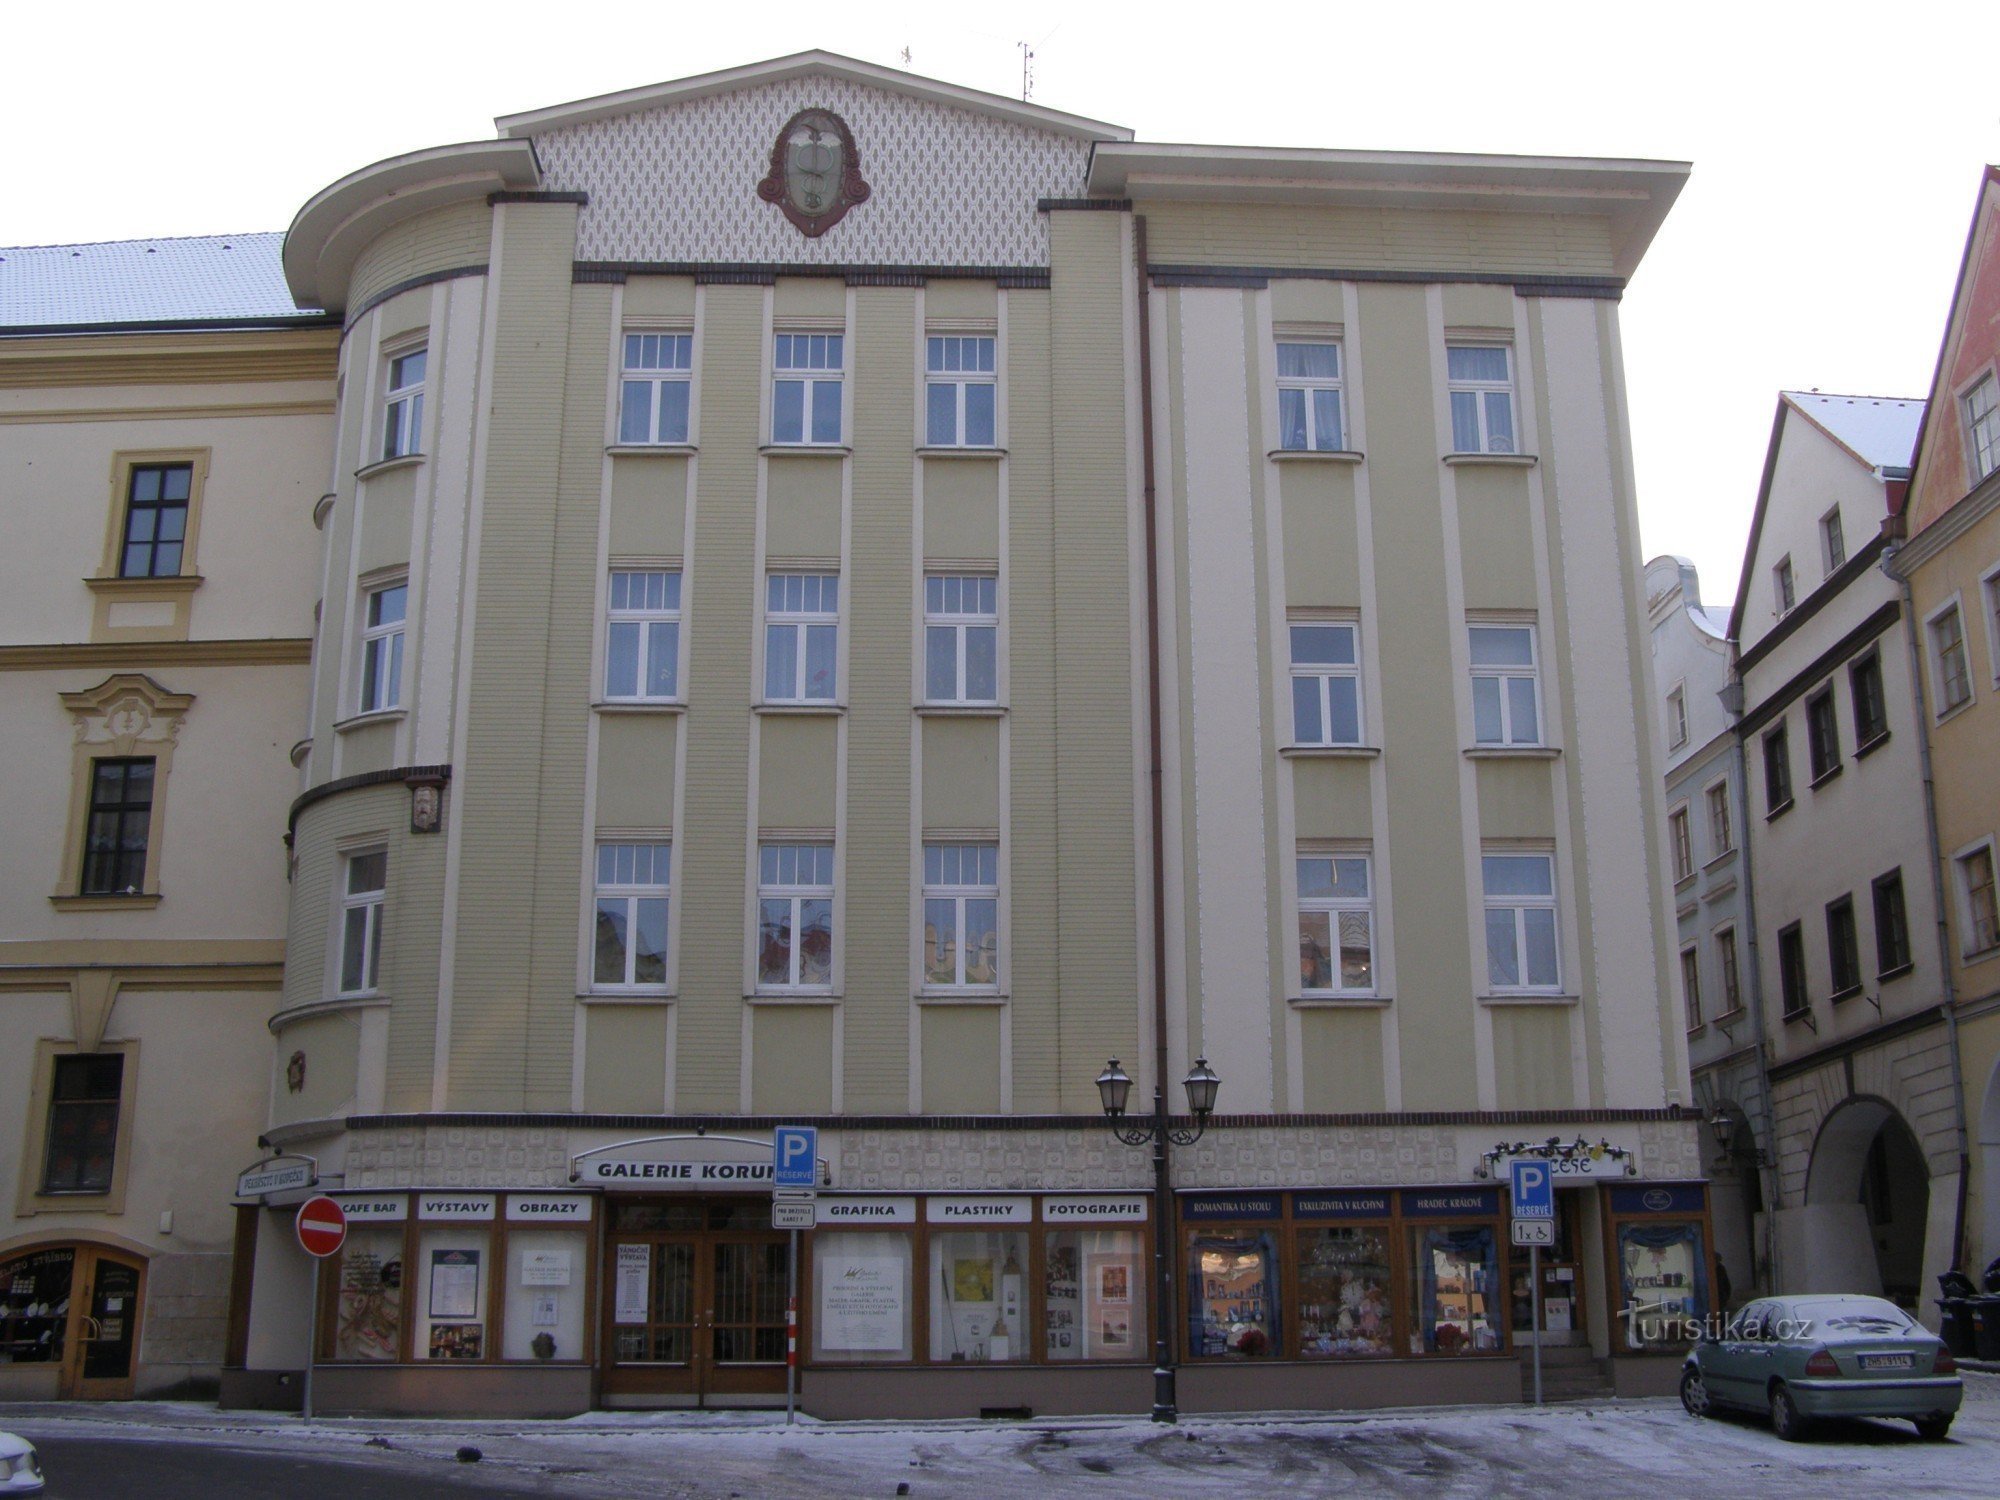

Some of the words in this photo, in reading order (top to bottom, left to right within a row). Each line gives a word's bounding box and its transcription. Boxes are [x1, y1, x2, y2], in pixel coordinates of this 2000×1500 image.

[783, 1134, 808, 1167] P
[597, 1163, 692, 1179] GALERIE
[1551, 1157, 1592, 1174] CESE
[1519, 1166, 1543, 1200] P
[425, 1201, 490, 1212] VÝSTAVY
[1193, 1202, 1238, 1212] ROMANTIKA
[1240, 1202, 1246, 1211] U
[1248, 1202, 1272, 1211] STOLU
[1299, 1201, 1343, 1211] EXKLUZIVITA
[1344, 1201, 1350, 1210] V
[1417, 1198, 1448, 1208] HRADEC
[1450, 1196, 1482, 1208] KRÁLOVÉ
[342, 1203, 370, 1213] CAFE
[373, 1203, 397, 1212] BAR
[519, 1203, 579, 1213] OBRAZY
[830, 1205, 896, 1215] GRAFIKA
[945, 1205, 1014, 1215] PLASTIKY
[1049, 1203, 1141, 1215] FOTOGRAFIE
